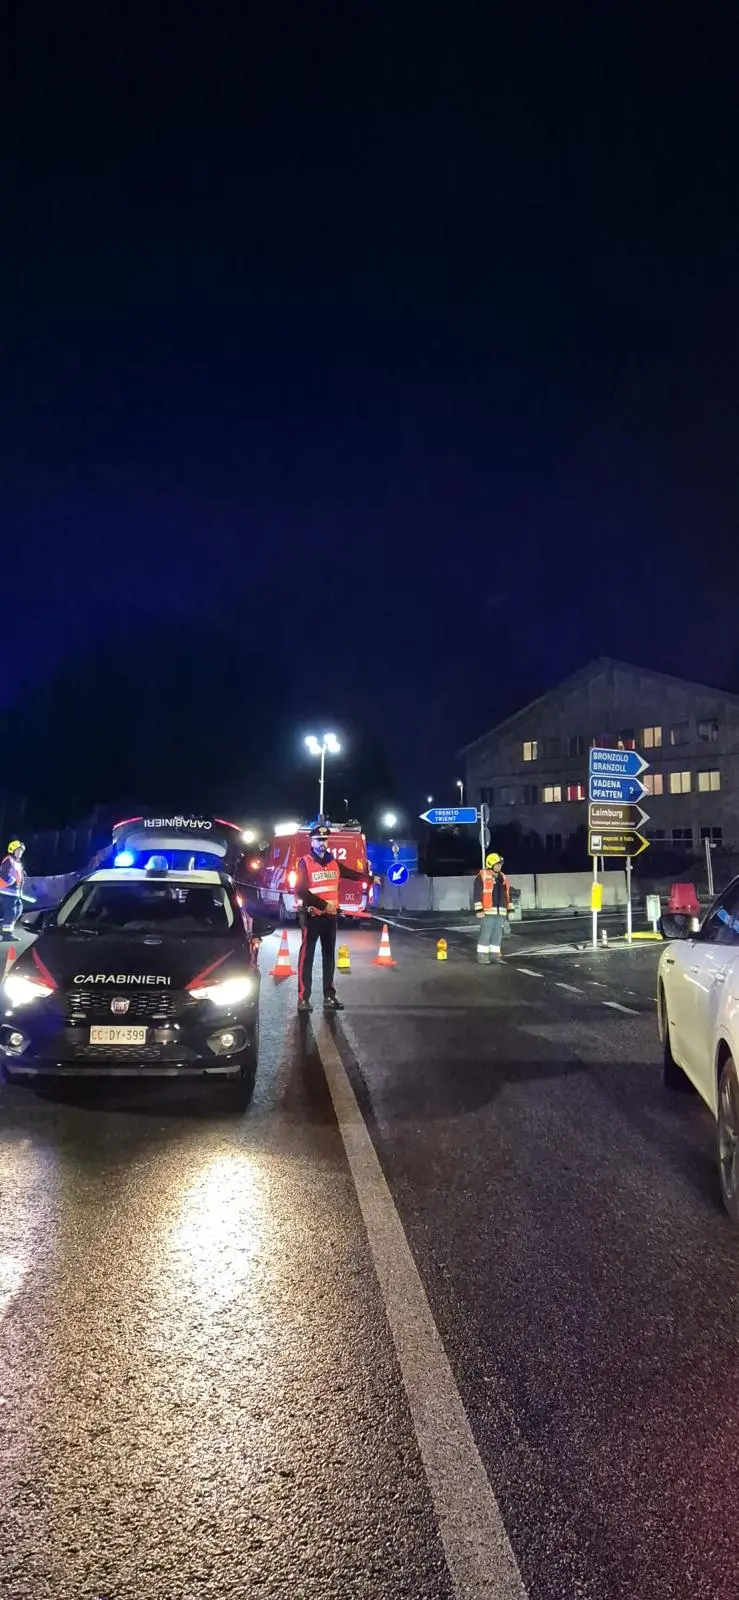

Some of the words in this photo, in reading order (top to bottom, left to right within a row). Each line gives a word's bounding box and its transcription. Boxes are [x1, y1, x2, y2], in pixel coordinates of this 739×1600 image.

[593, 752, 629, 762] BRONZOLO
[593, 762, 626, 772] BRANZOLL
[593, 780, 621, 788] VADENA
[592, 790, 623, 799] PFATTEN
[629, 786, 634, 794] 2
[591, 807, 623, 819] Laimburg
[144, 818, 212, 830] CARABINIERI
[73, 974, 171, 985] CARABINIERI
